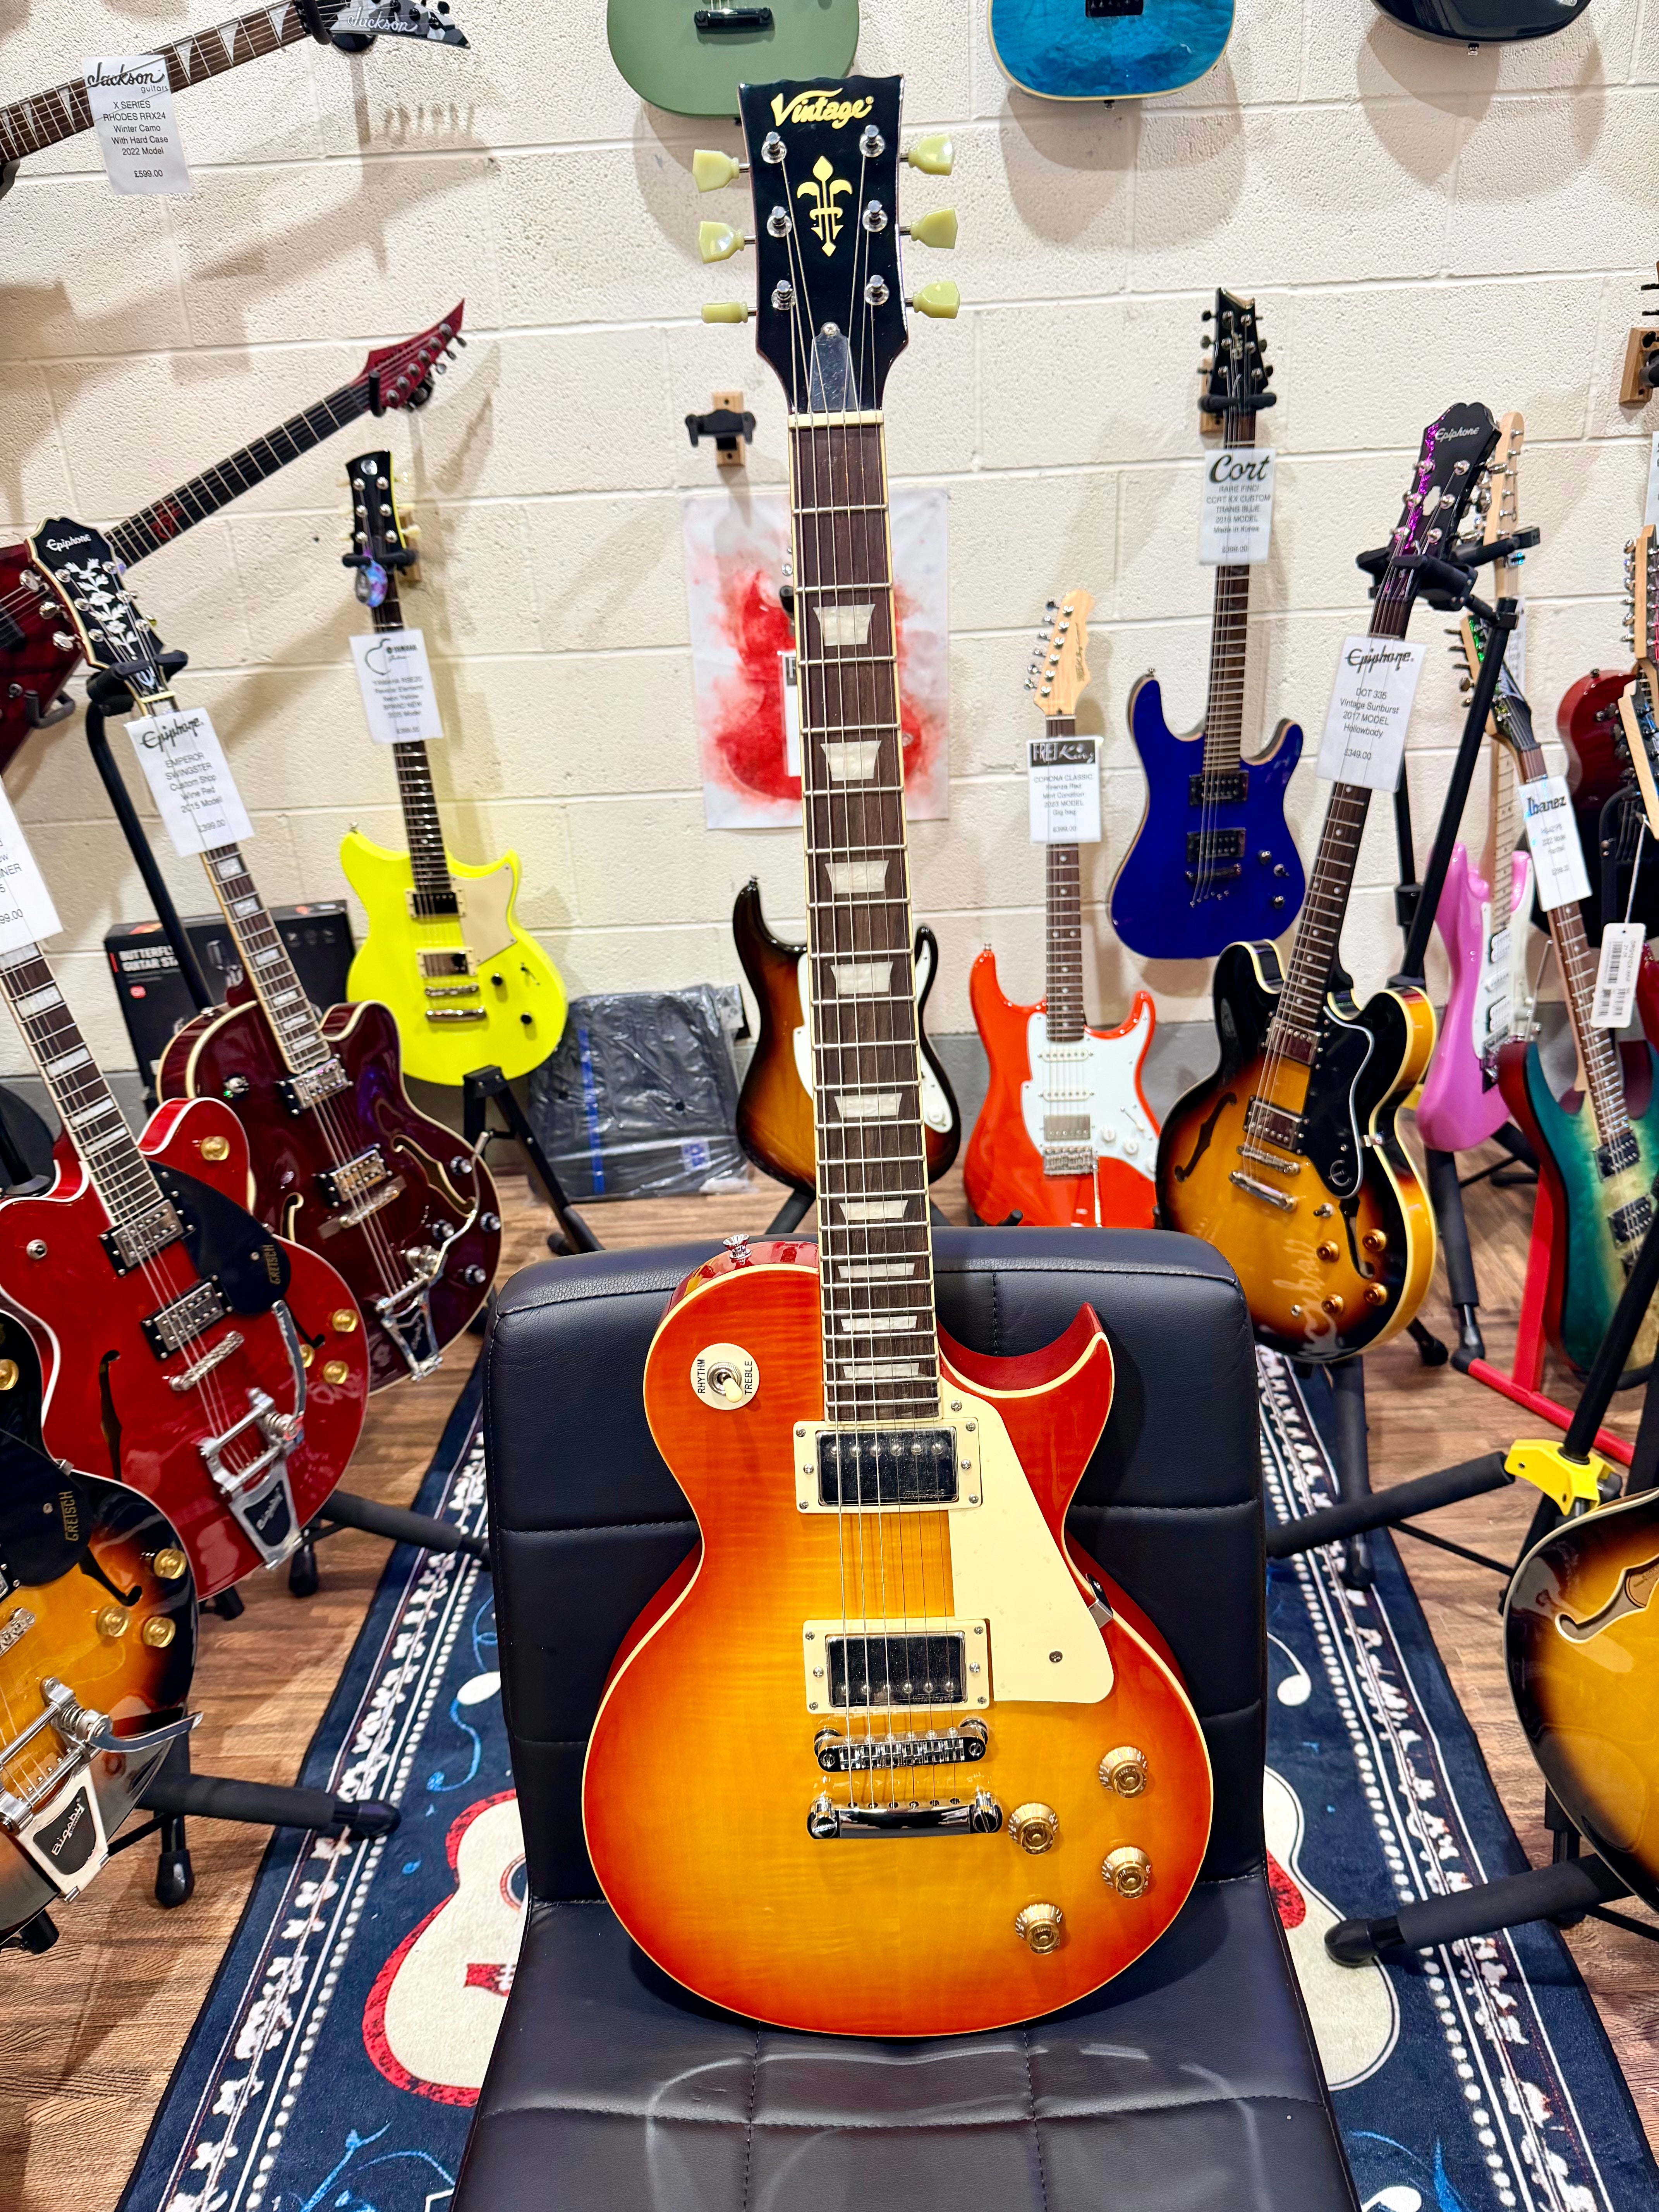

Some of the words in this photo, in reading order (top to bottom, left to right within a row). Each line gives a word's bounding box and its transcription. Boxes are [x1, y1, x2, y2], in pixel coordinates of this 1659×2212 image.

[347, 6, 418, 32] Jackson
[87, 62, 165, 88] Jackson
[141, 85, 168, 93] guitars
[121, 101, 151, 109] SERIES
[771, 88, 873, 129] Vintage
[103, 113, 138, 121] RHODES
[134, 170, 163, 178] £599.00
[1434, 426, 1480, 442] Epiphone
[1209, 455, 1270, 484] Cort
[45, 534, 92, 551] Epiphone
[1345, 645, 1412, 673] Epiphone
[1356, 688, 1372, 697] DOT
[1373, 690, 1388, 700] 335
[1340, 698, 1365, 709] Vintage
[1366, 702, 1400, 714] Sunburst
[1343, 711, 1361, 721] 2017
[1362, 713, 1389, 726] MODEL
[1343, 723, 1383, 738] Hollowbody
[1344, 748, 1371, 760] £349.00
[1527, 795, 1566, 816] Ibanez
[697, 1359, 705, 1393] RHYTHM
[58, 1491, 79, 1541] GRETSCH
[51, 1803, 85, 1856] Bigsby
